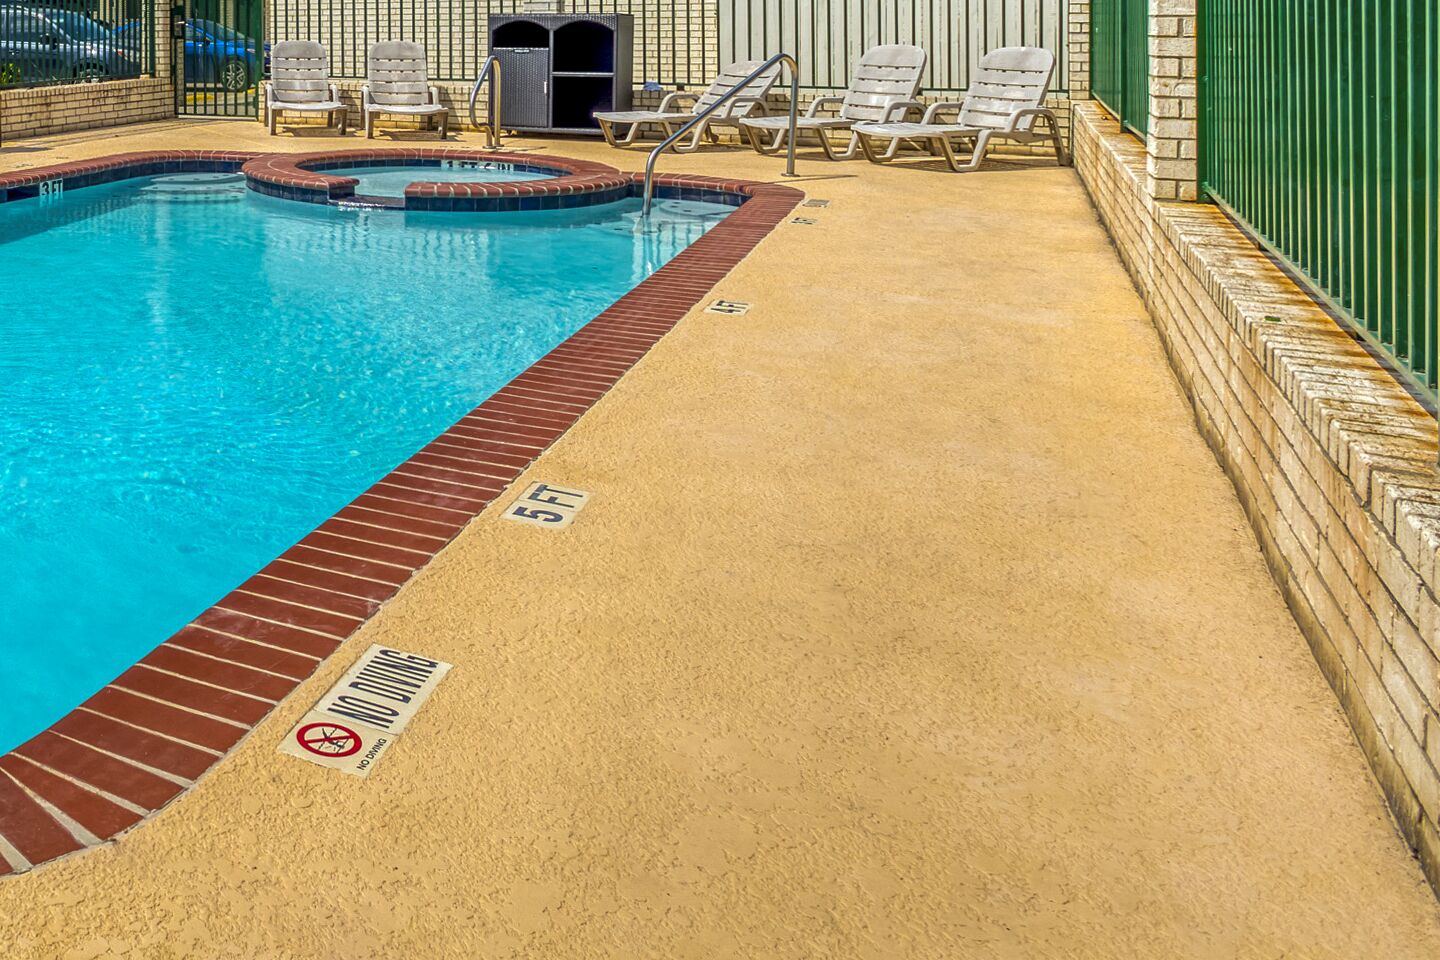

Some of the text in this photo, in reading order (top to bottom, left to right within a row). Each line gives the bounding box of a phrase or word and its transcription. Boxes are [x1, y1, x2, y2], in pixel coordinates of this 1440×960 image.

[42, 179, 63, 195] 3 FT
[512, 483, 584, 523] 5 FT
[326, 649, 440, 729] NO DIVING
[356, 737, 388, 771] NO DIVING
